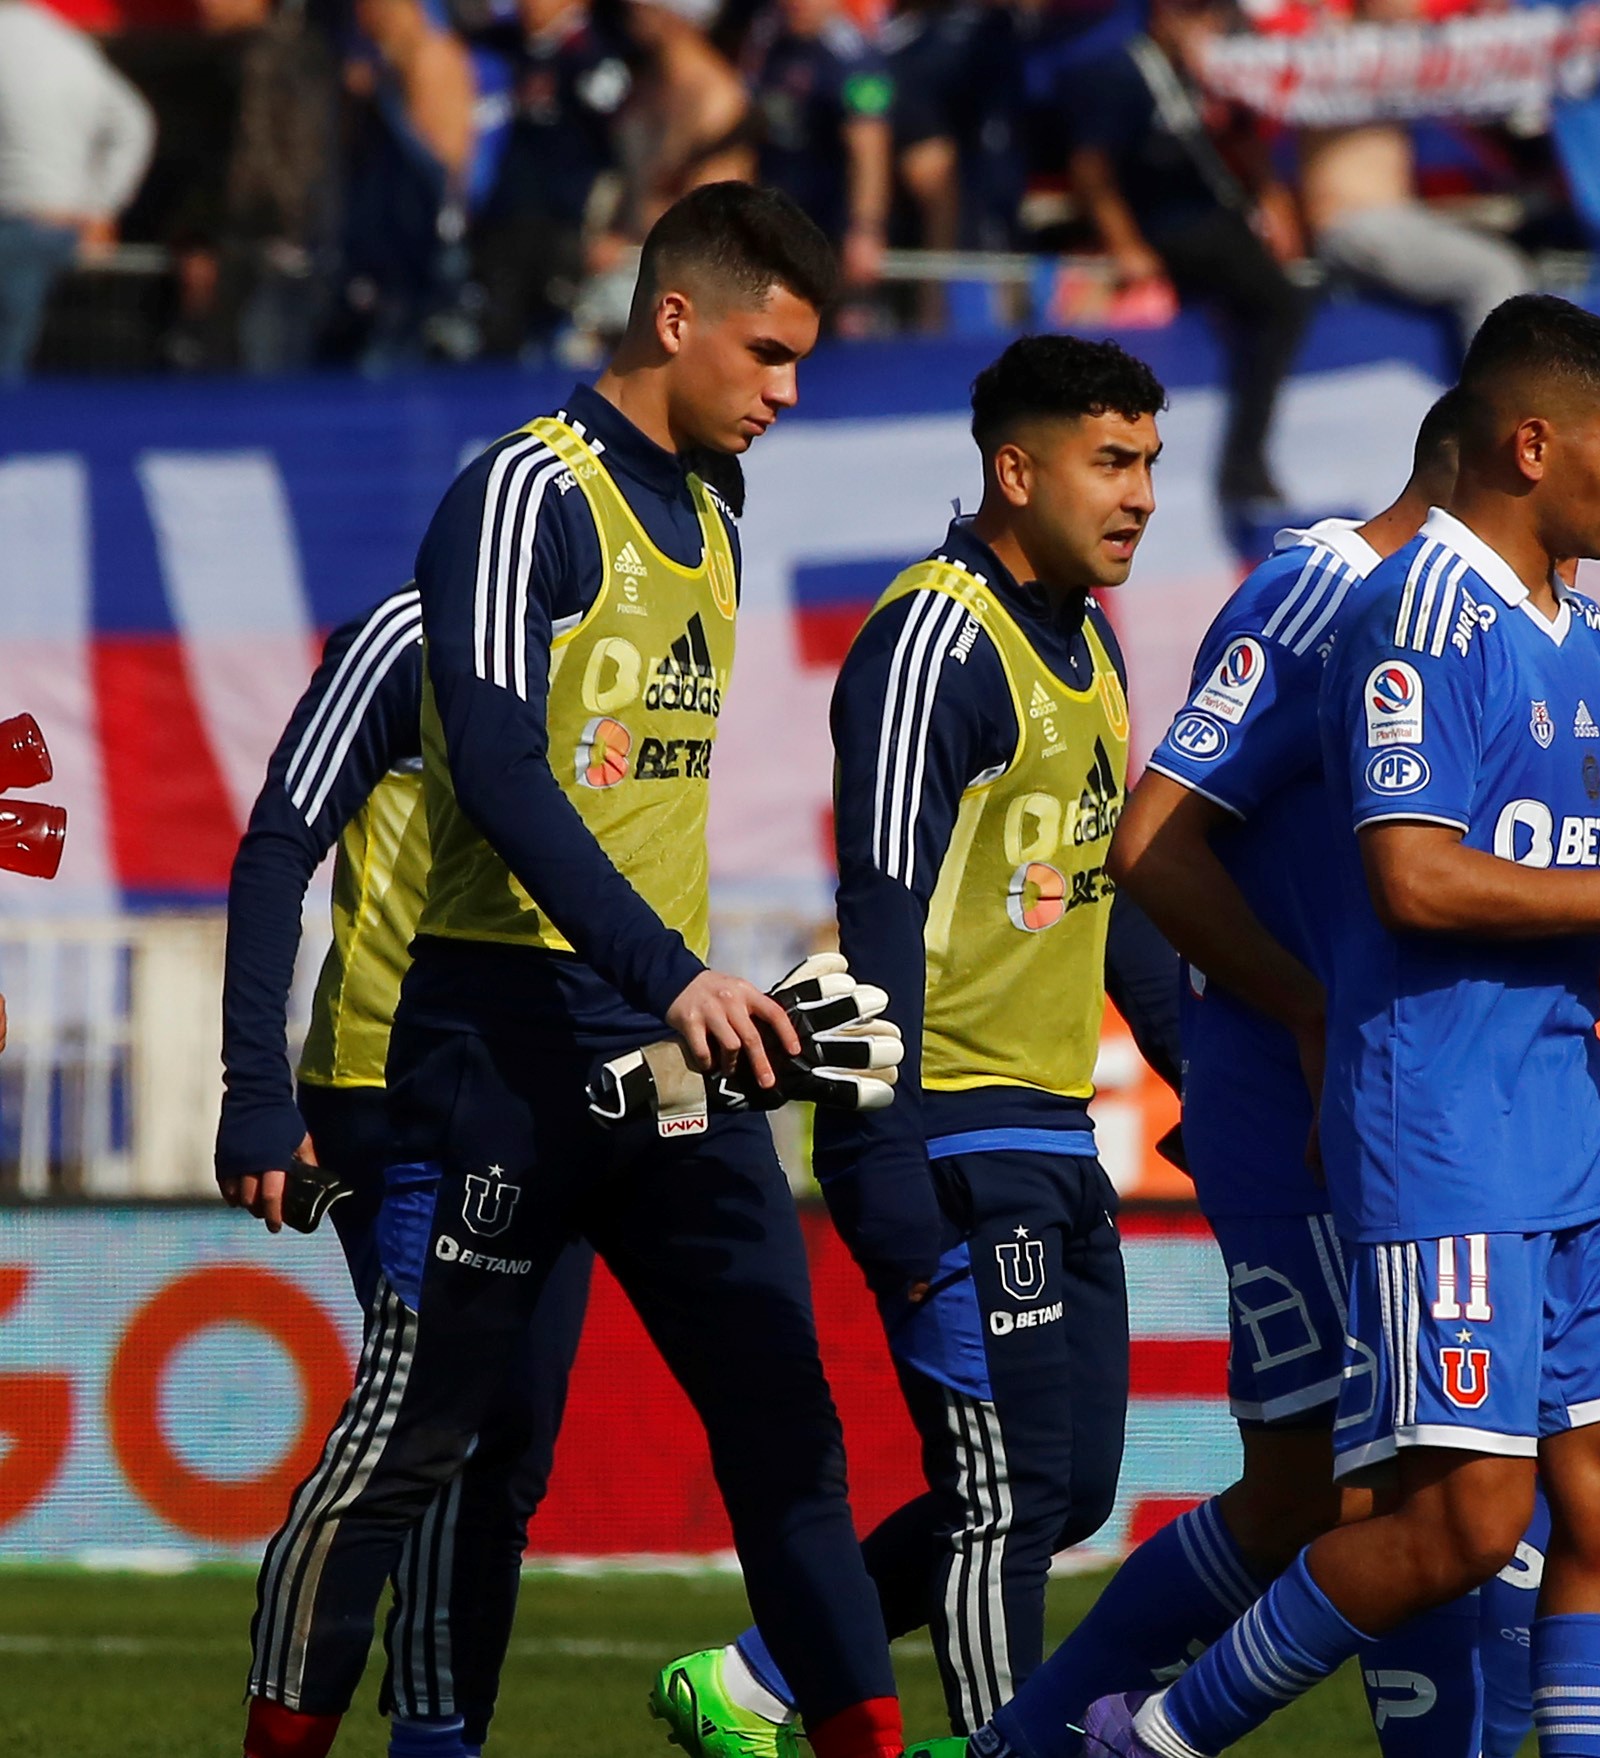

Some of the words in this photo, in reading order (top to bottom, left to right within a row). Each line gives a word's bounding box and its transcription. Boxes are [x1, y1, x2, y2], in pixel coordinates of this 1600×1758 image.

[614, 560, 648, 577] adidas
[1177, 720, 1214, 748] PF
[1379, 757, 1411, 785] PF
[459, 1248, 532, 1274] BETANO
[1432, 1233, 1492, 1322] 11
